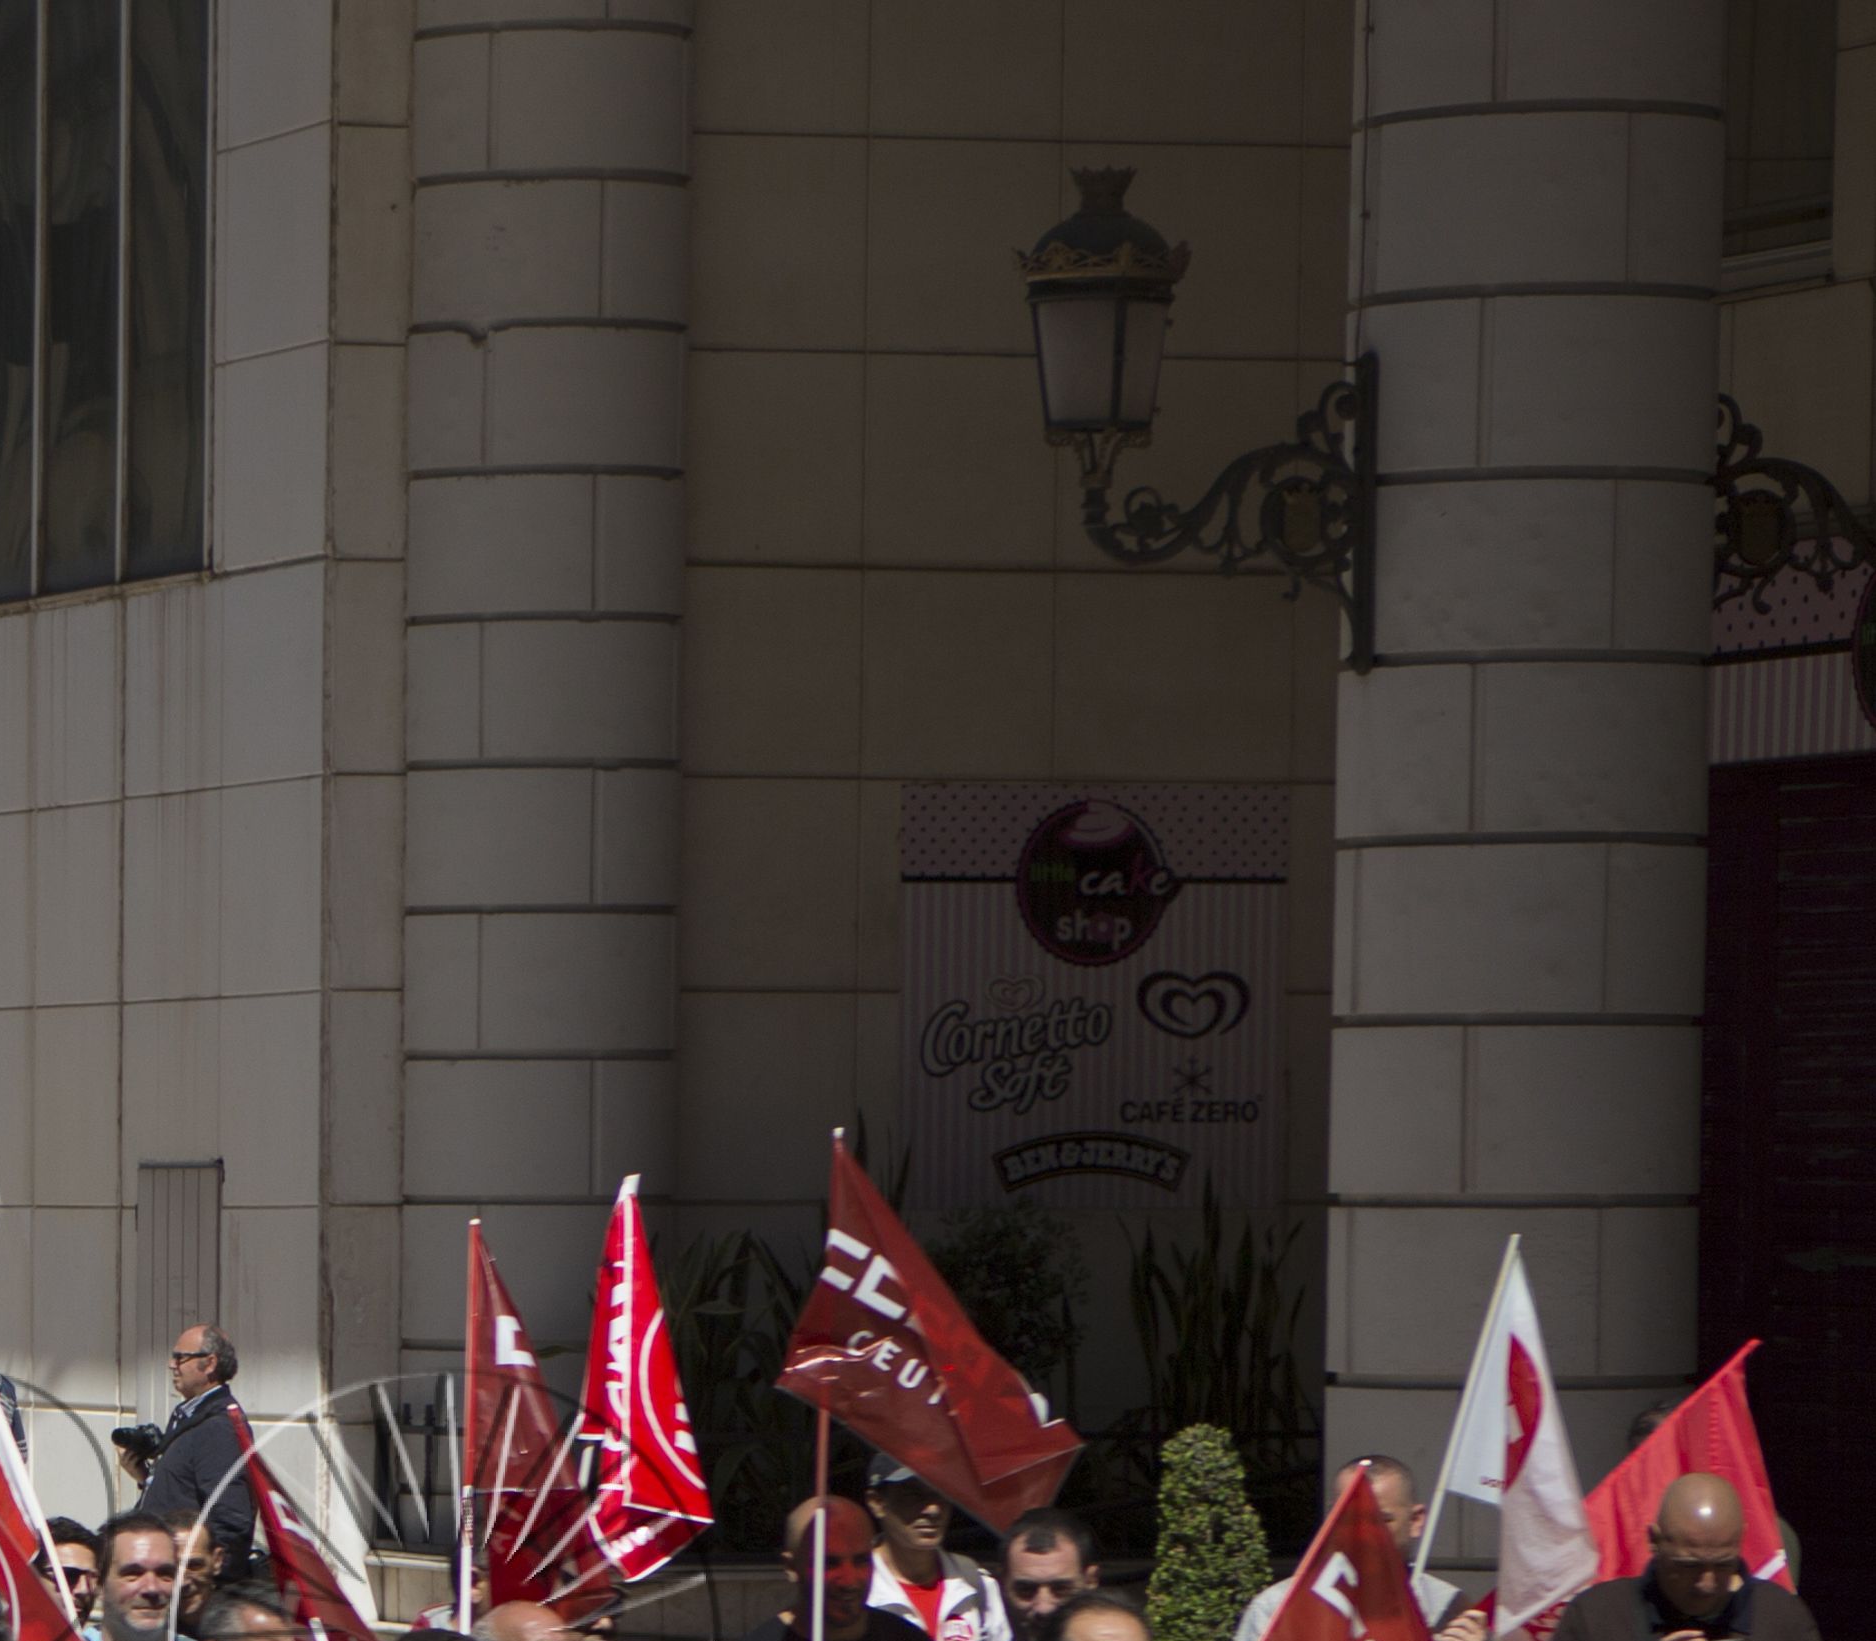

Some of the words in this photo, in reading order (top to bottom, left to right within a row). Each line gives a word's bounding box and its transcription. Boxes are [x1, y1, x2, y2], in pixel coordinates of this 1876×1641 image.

[1078, 851, 1174, 897] cake
[1055, 908, 1134, 951] shop
[920, 996, 1113, 1078] Cornetto
[967, 1051, 1074, 1115] Soft
[1119, 1095, 1187, 1124] CAFÉ
[1190, 1099, 1260, 1124] ZERO
